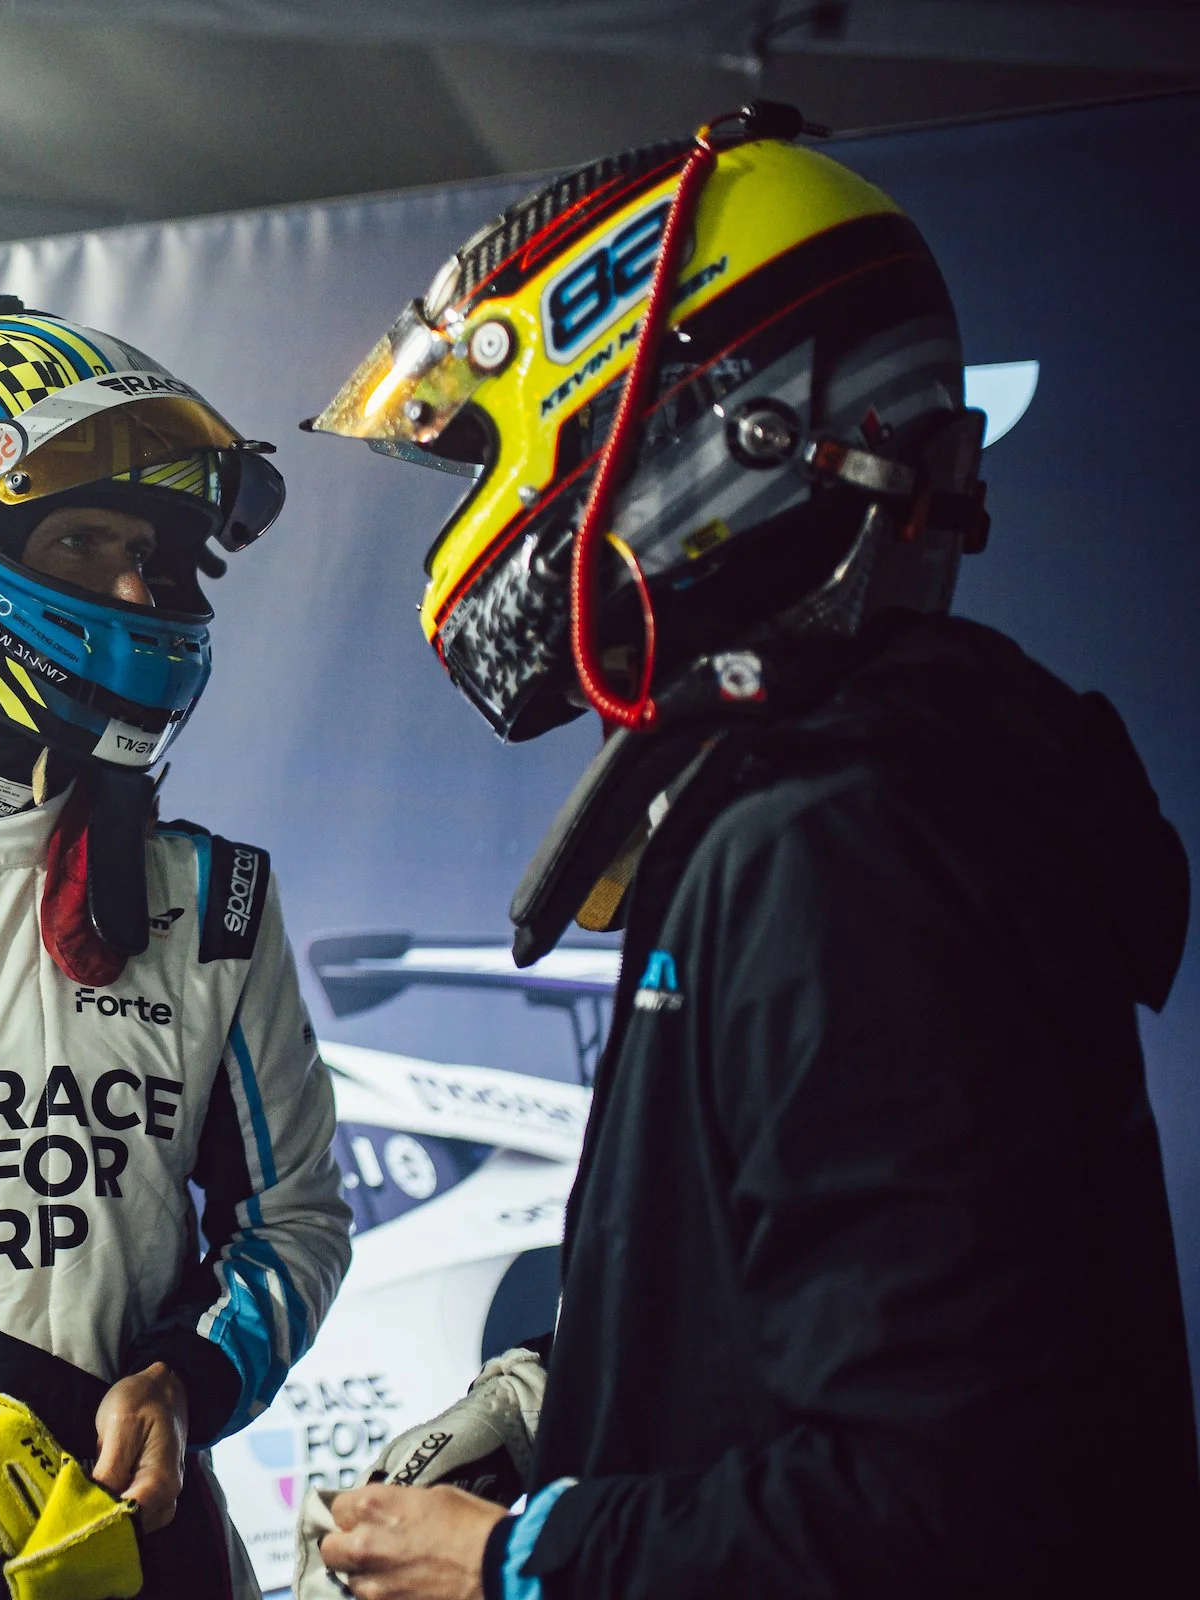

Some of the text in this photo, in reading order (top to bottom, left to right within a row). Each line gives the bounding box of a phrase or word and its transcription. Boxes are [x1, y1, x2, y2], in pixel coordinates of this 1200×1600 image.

[540, 342, 613, 417] KEVIN
[75, 987, 172, 1025] Forte
[283, 1374, 402, 1414] RACE
[394, 1432, 449, 1487] parco
